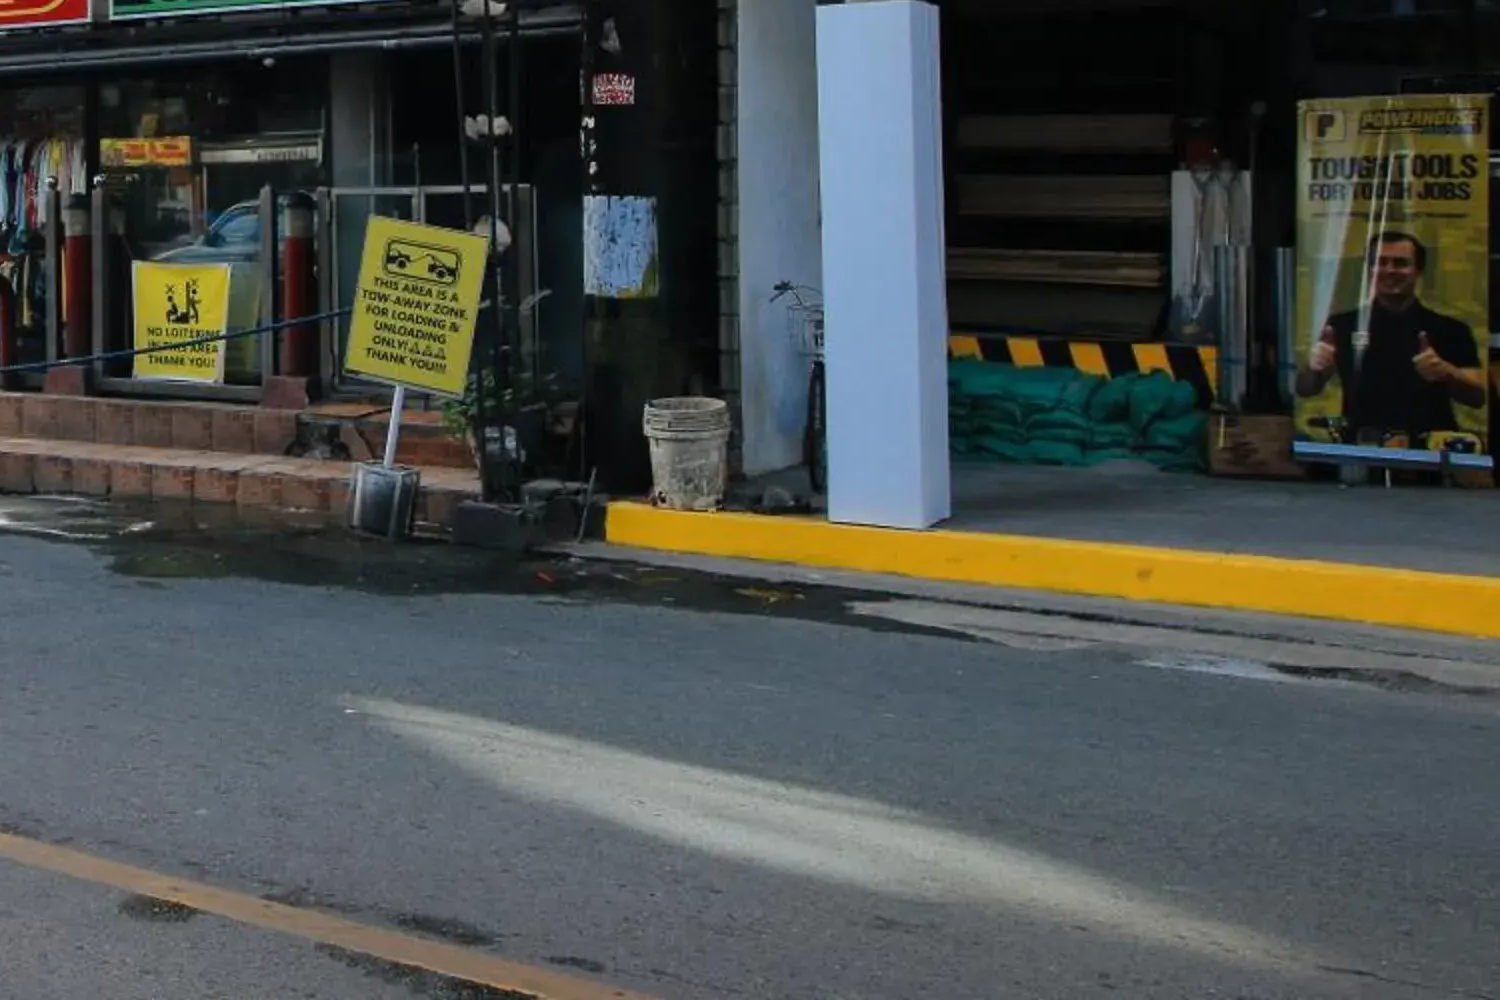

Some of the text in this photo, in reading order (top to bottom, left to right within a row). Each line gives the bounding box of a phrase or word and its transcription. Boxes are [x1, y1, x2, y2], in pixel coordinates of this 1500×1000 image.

[1417, 182, 1471, 201] JOBS
[373, 277, 399, 292] THIS
[402, 283, 433, 298] AREA
[450, 294, 459, 302] A
[366, 305, 388, 318] FOR
[392, 311, 446, 331] LOADING
[374, 320, 447, 345] UNLOADING
[366, 347, 405, 365] THANK
